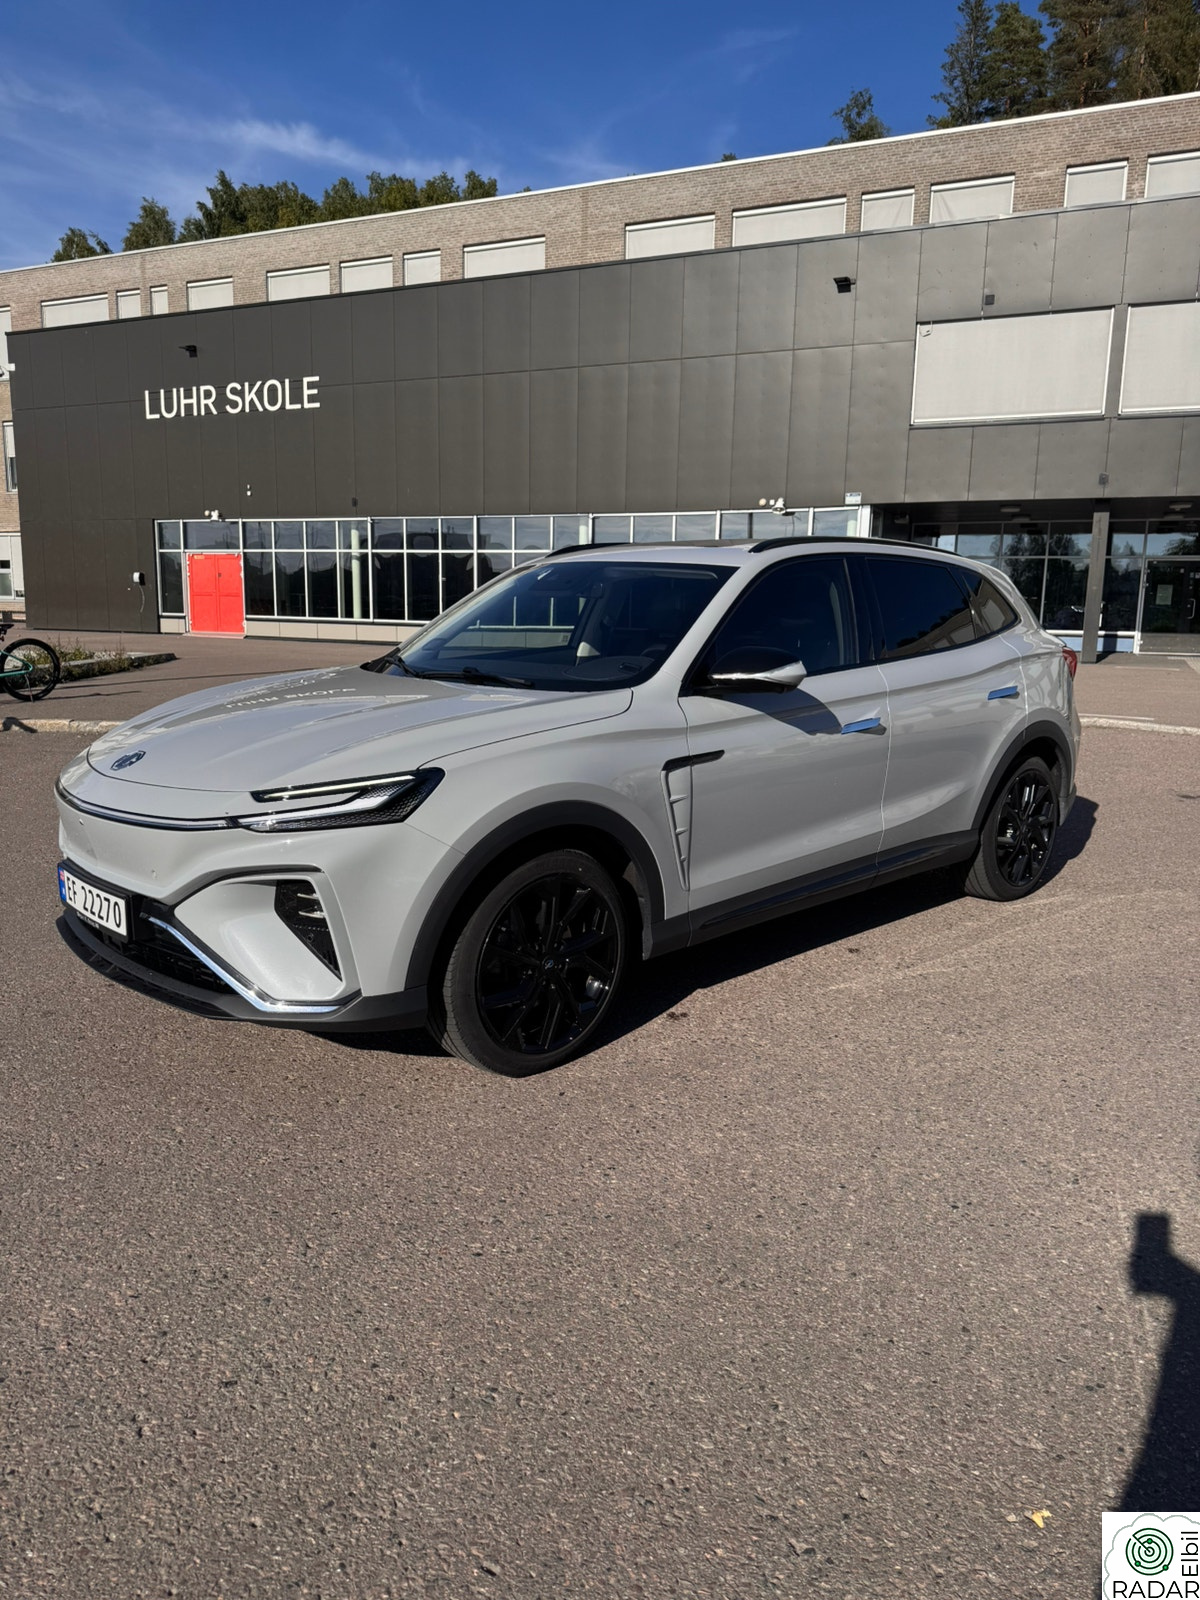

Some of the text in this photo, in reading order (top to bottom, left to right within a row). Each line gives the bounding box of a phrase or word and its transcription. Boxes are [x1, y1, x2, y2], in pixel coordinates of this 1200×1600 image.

[144, 376, 320, 420] LUHR SKOLE
[66, 876, 77, 905] EF
[81, 885, 121, 928] 22270
